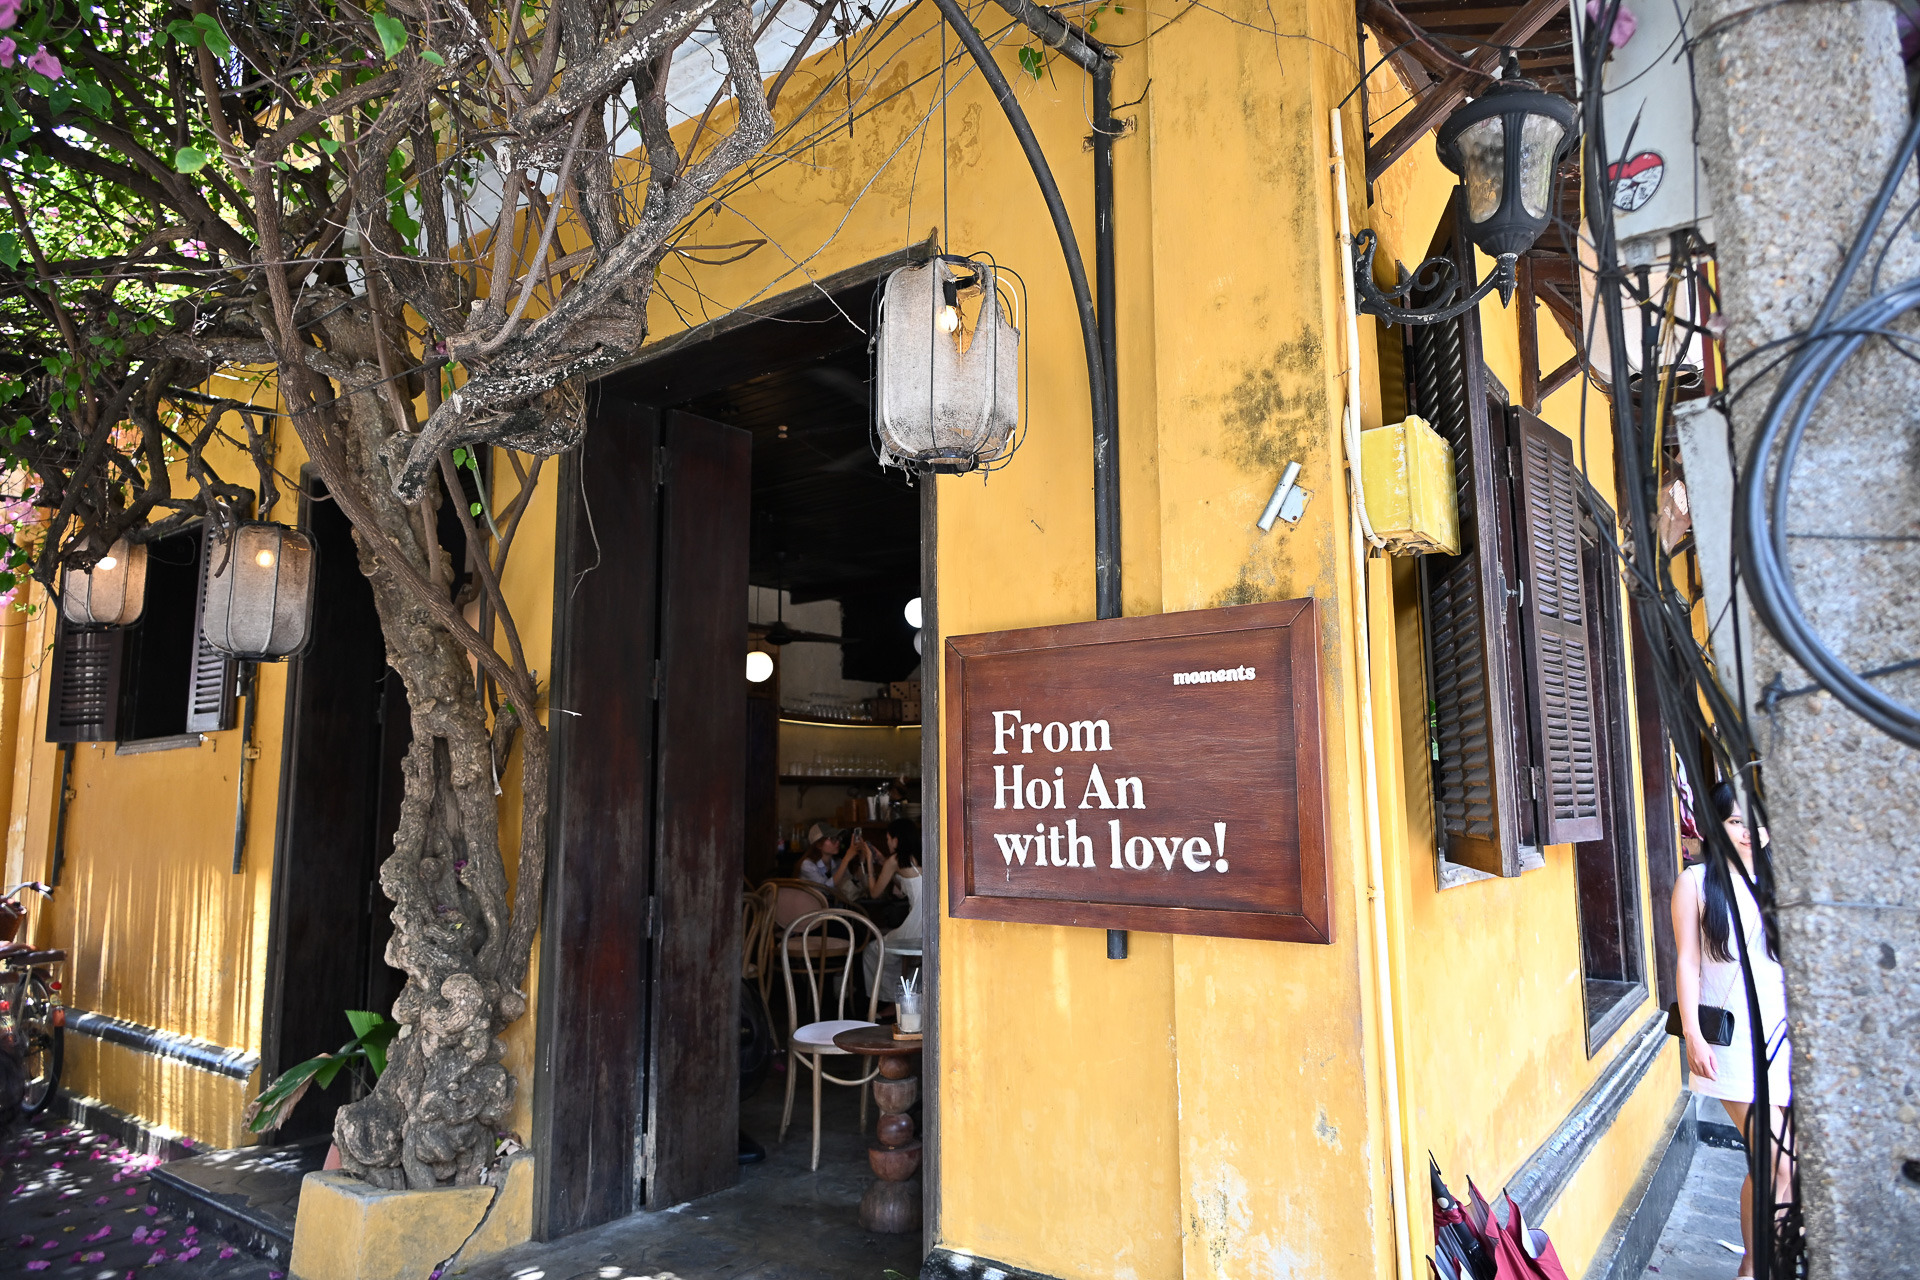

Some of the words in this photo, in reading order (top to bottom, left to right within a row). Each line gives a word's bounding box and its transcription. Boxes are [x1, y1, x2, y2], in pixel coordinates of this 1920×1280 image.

[1172, 664, 1257, 686] moments
[991, 709, 1113, 755] From
[992, 764, 1067, 810] Hoi
[1077, 762, 1147, 810] An
[993, 818, 1097, 869] with
[1107, 818, 1229, 874] love!
